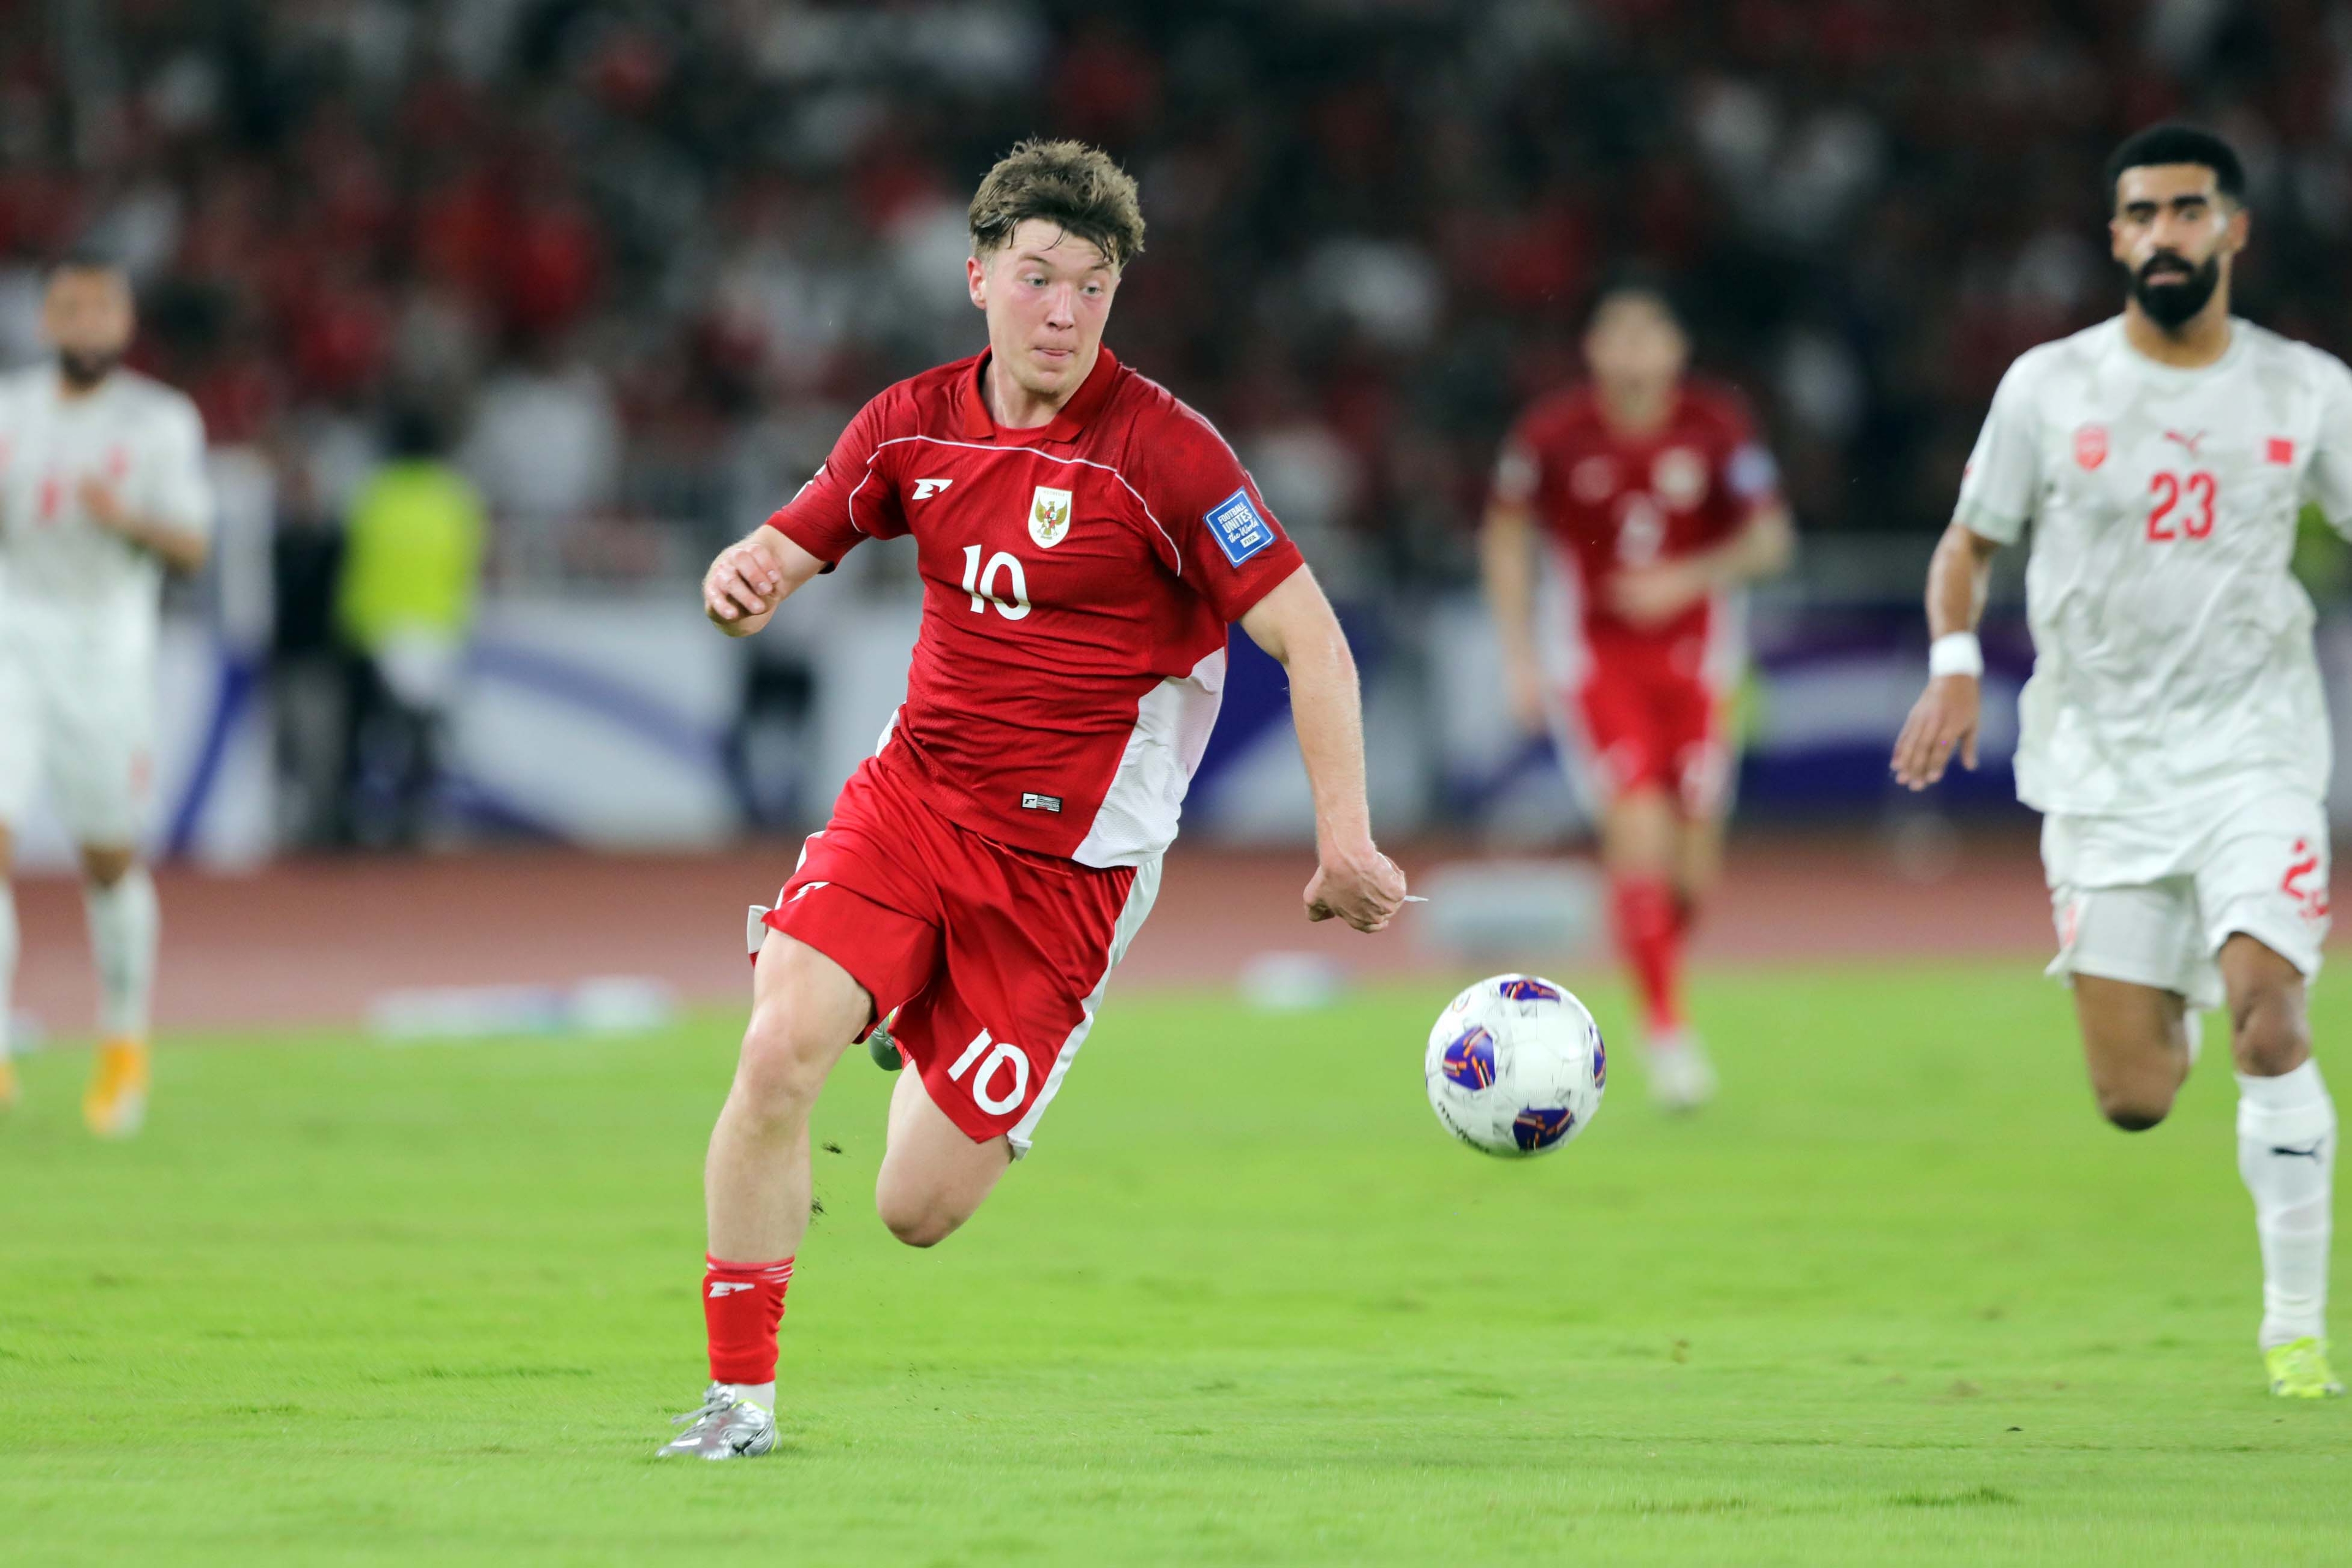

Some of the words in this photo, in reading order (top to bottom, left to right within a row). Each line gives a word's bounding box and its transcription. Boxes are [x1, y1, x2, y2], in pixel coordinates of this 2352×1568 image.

[1217, 502, 1247, 524] FOOTBALL
[1222, 508, 1253, 533] UNITES
[1227, 531, 1241, 543] the
[1238, 517, 1259, 536] World
[2147, 471, 2215, 541] 23
[962, 543, 1031, 620] 10
[947, 1027, 1030, 1115] 10
